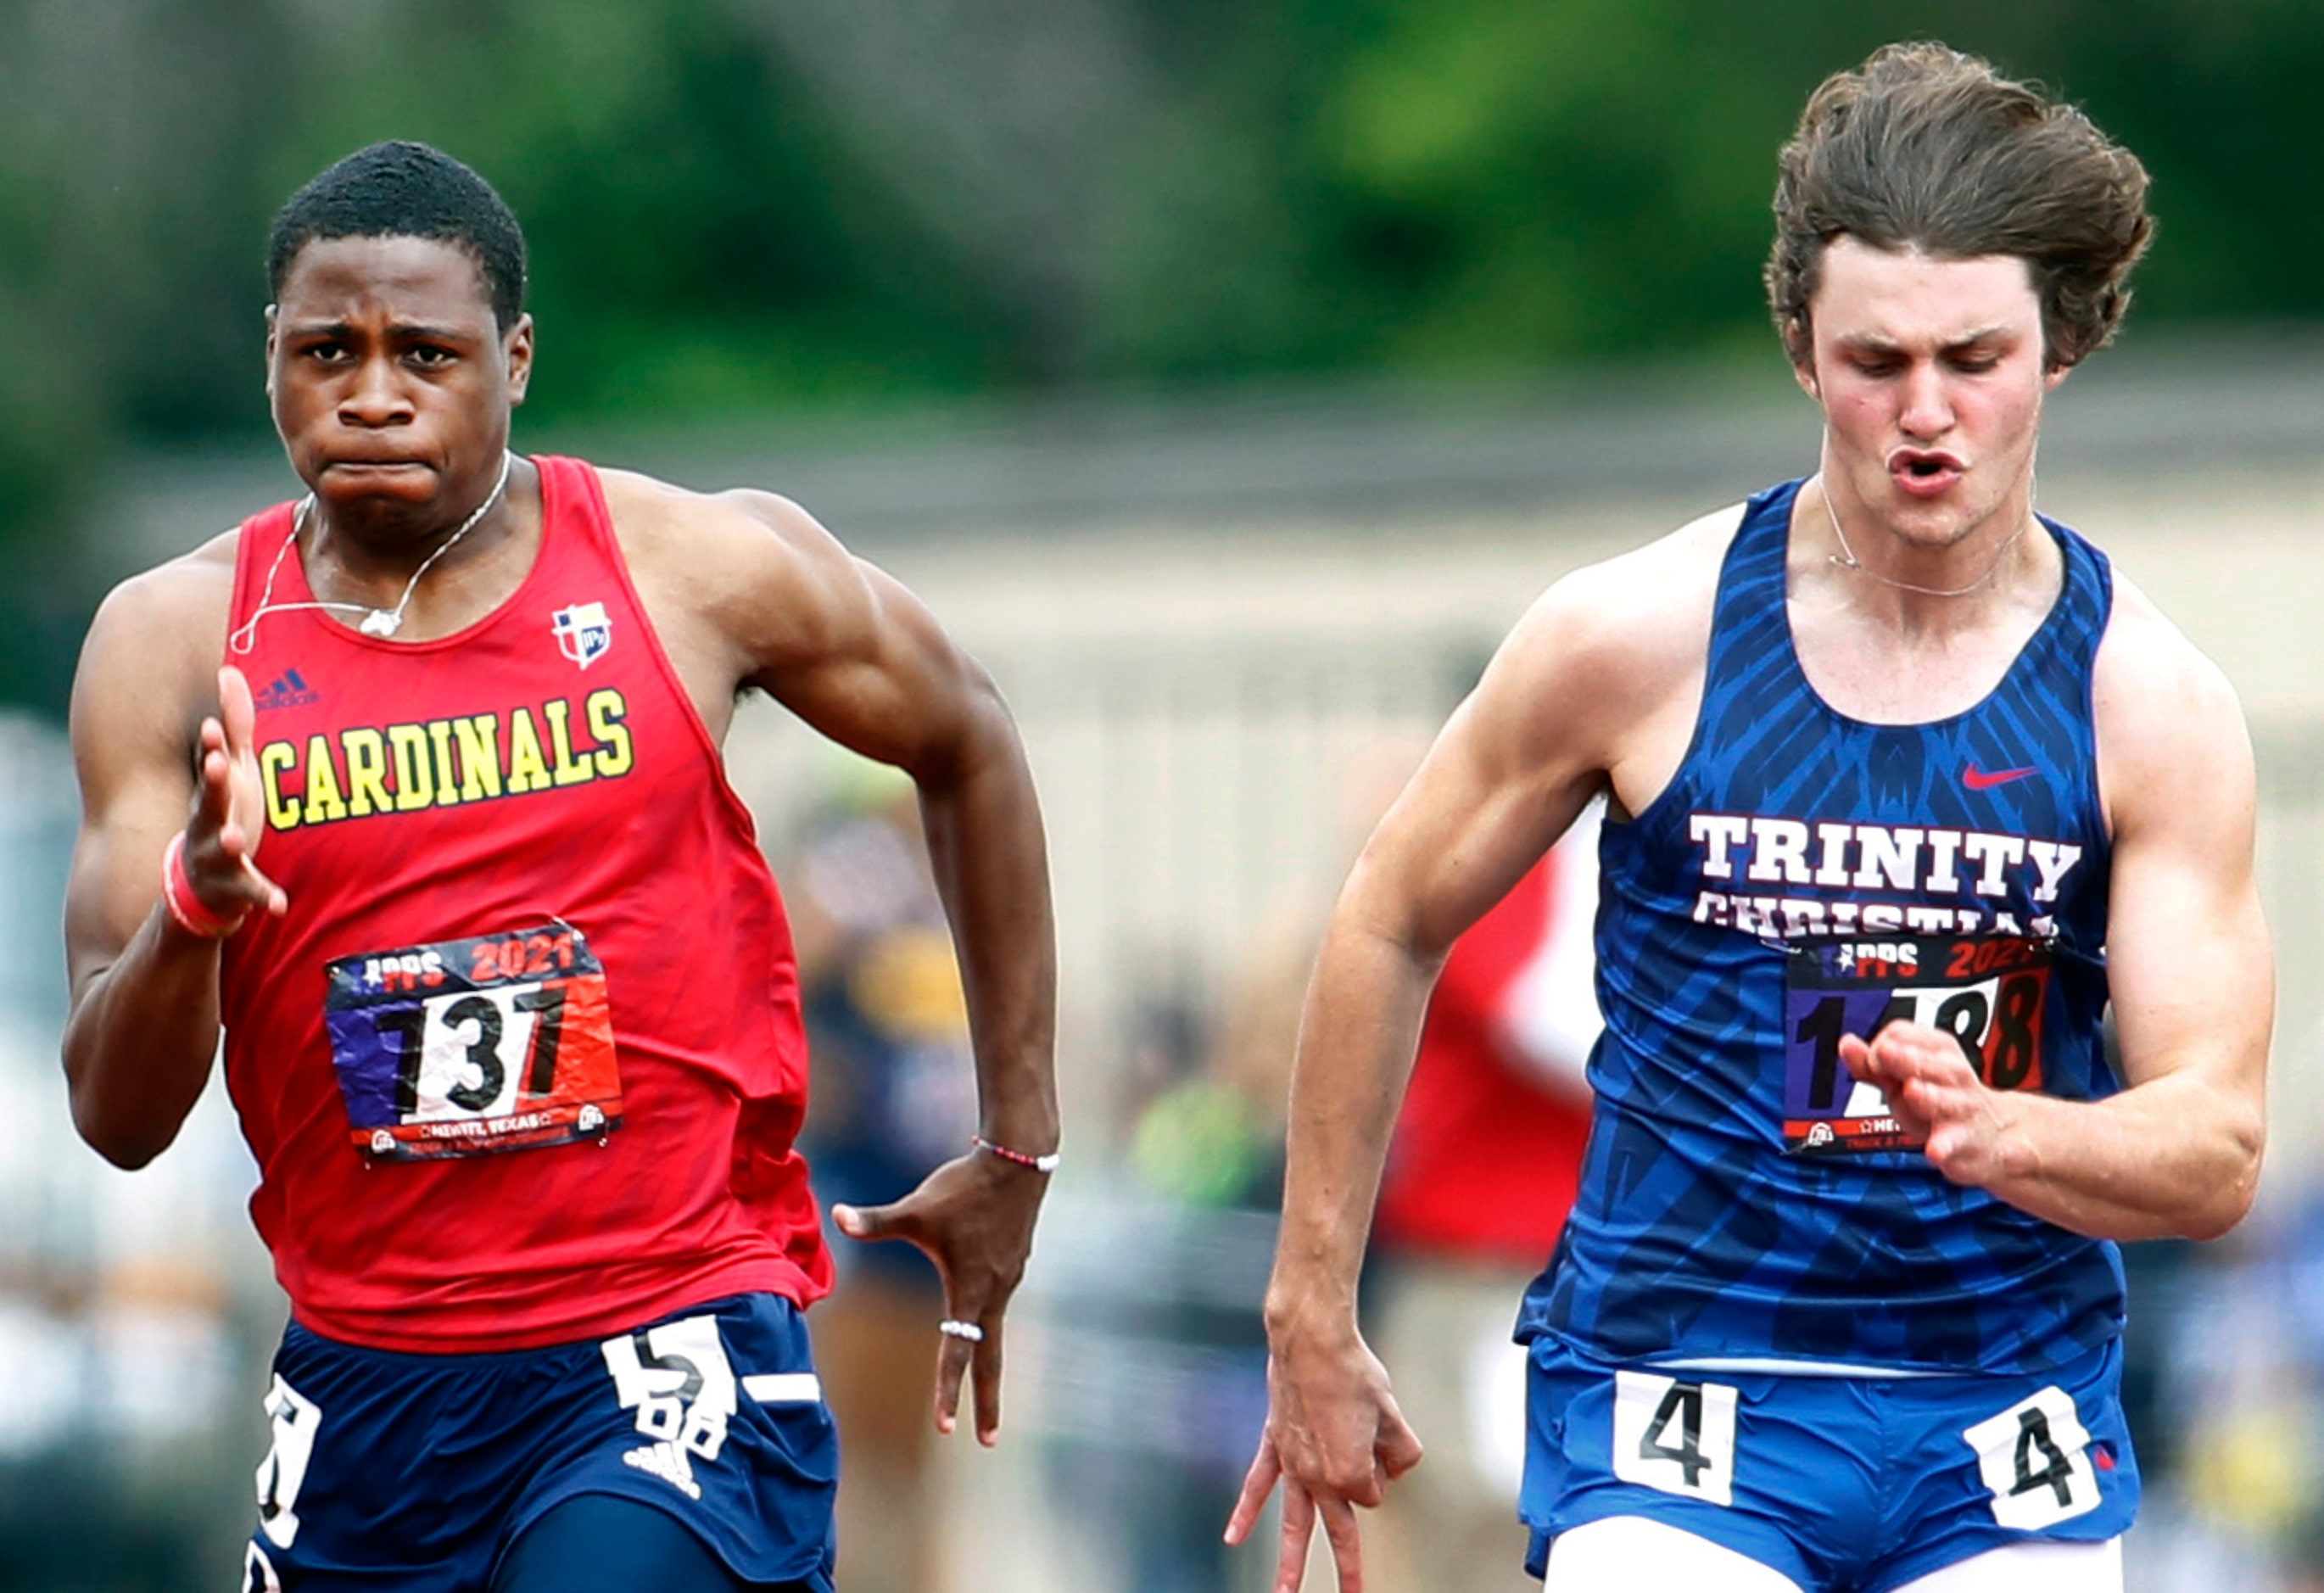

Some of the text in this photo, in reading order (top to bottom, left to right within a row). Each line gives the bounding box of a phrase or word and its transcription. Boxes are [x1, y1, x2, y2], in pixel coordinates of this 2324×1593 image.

[260, 688, 633, 832] CARDINALS
[1689, 813, 2082, 903] TRINITY
[471, 932, 574, 982] 2021
[489, 1113, 539, 1133] TEXAS
[1639, 1383, 1712, 1489] 4
[2008, 1406, 2075, 1508] 4
